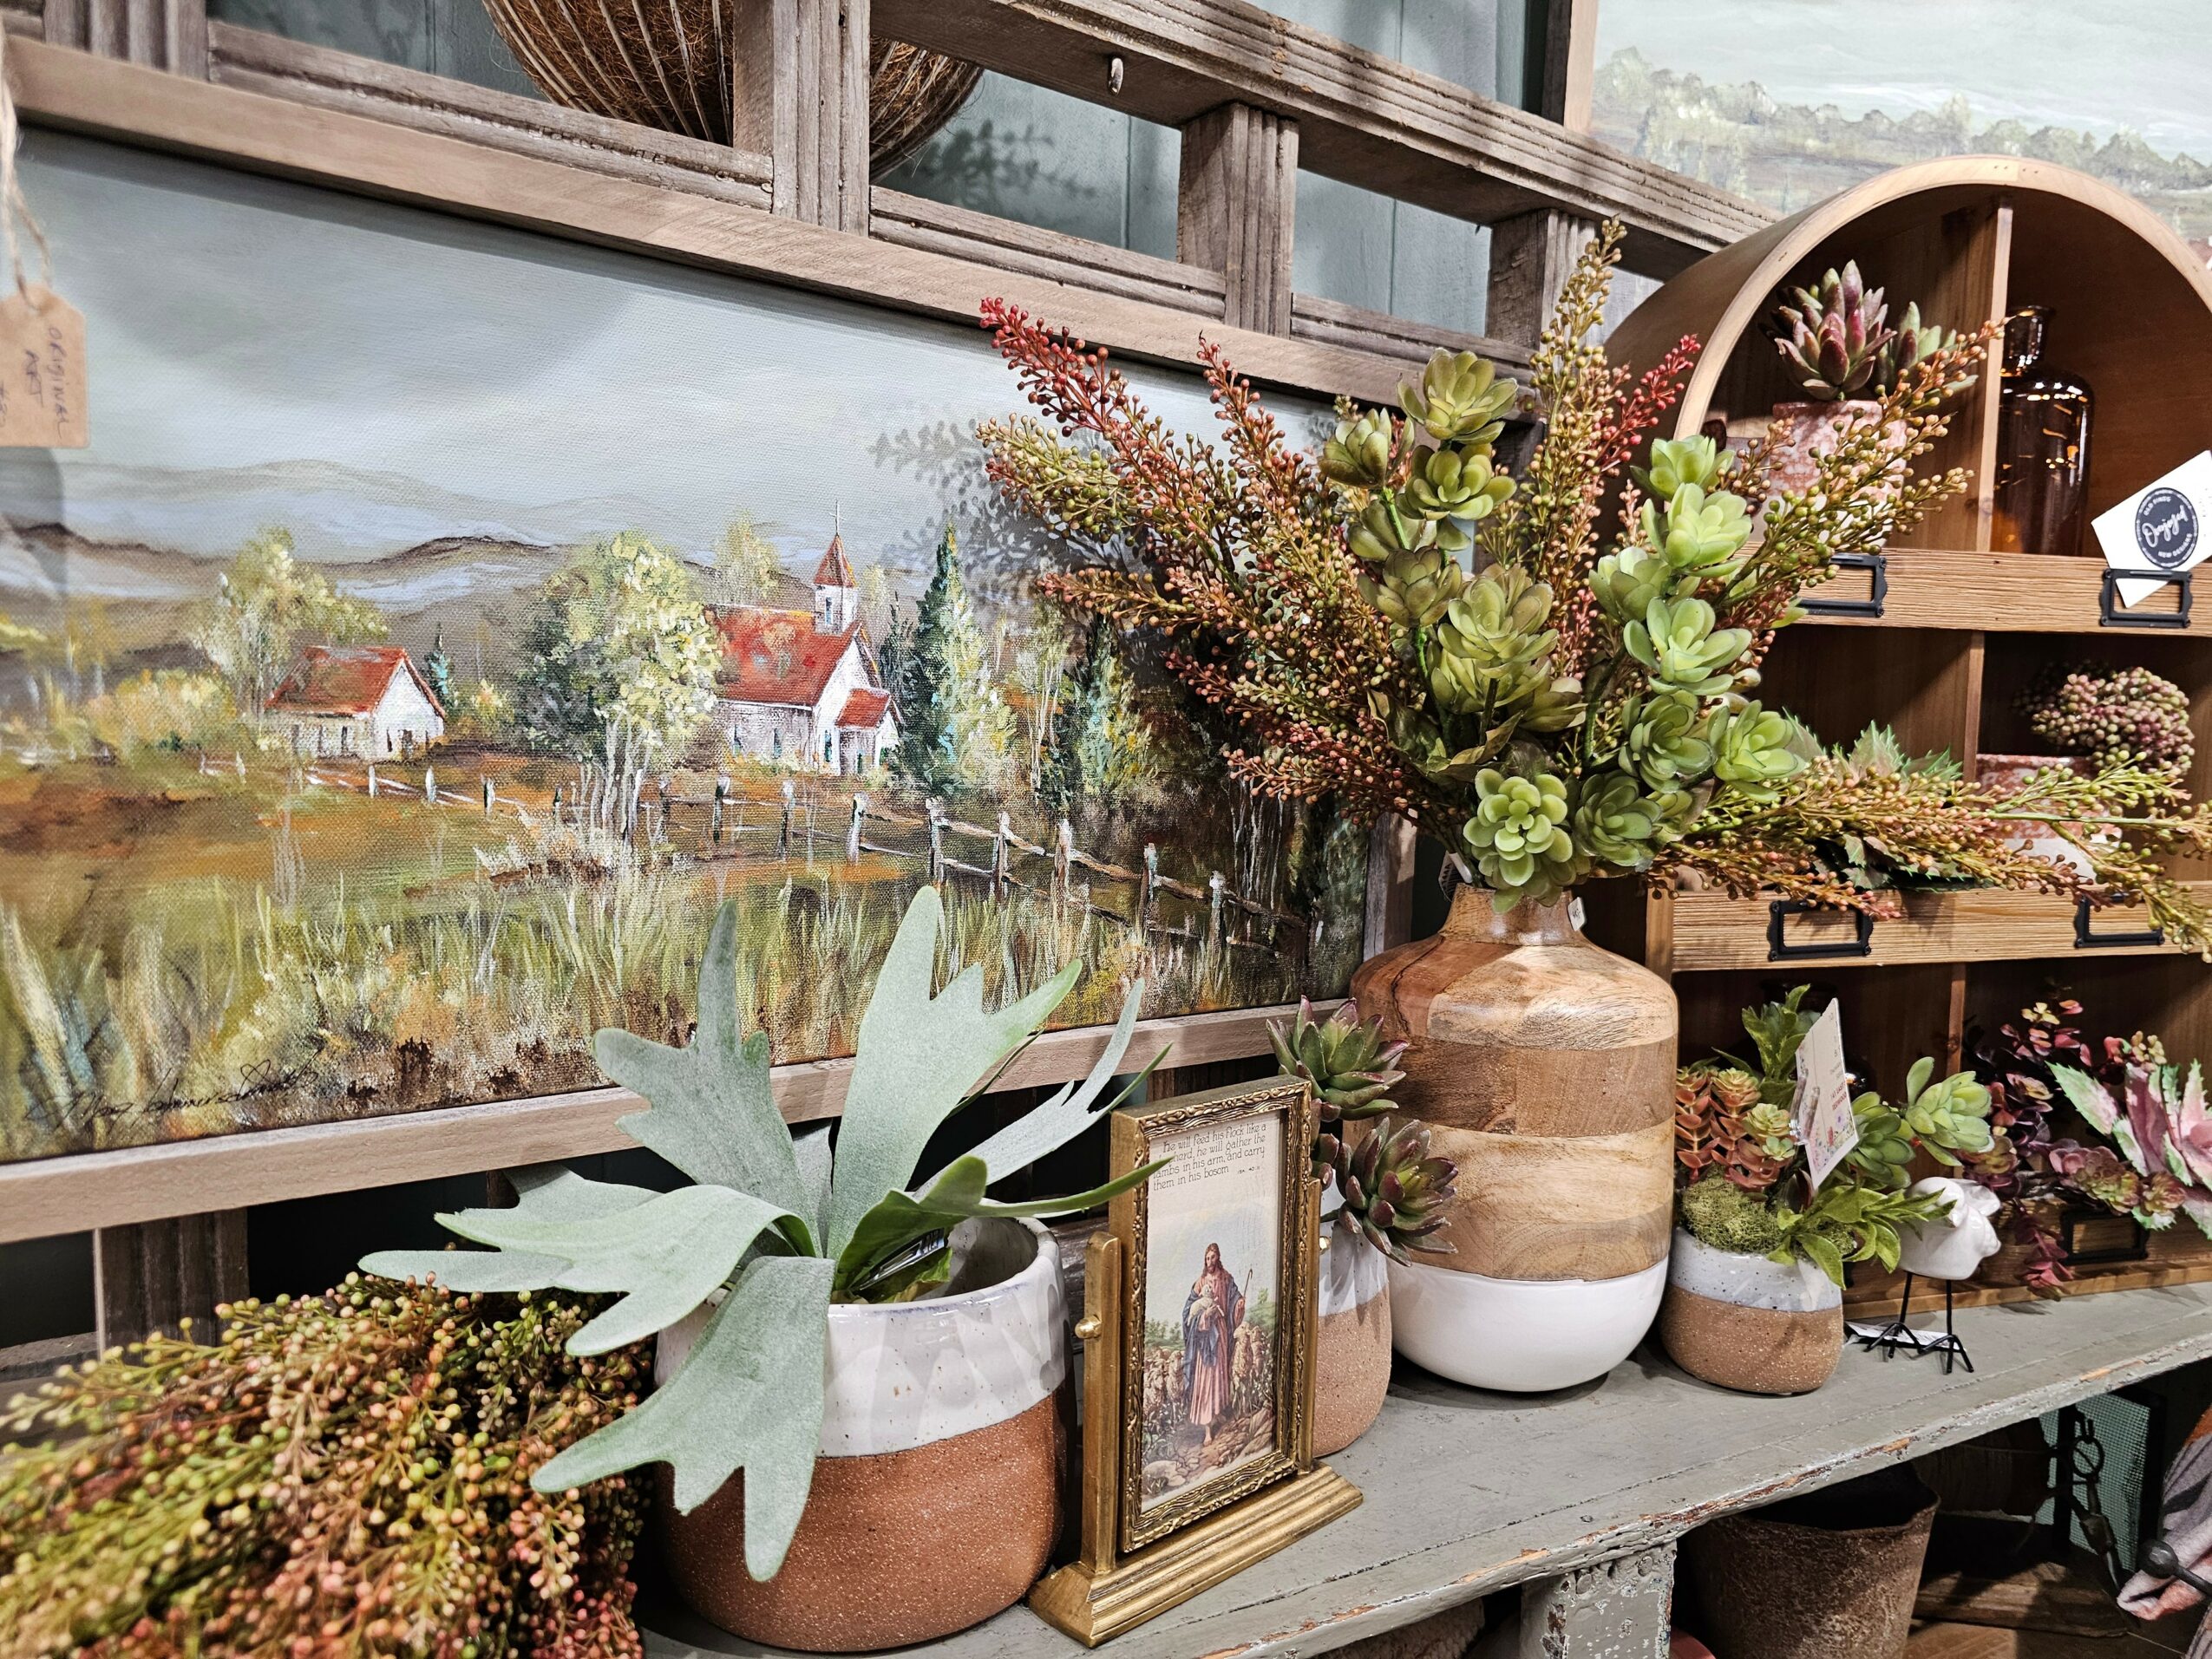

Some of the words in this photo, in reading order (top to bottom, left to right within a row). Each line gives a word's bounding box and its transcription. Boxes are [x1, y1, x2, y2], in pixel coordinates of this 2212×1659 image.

[1178, 1137, 1191, 1149] will
[1194, 1133, 1209, 1146] feed
[1213, 1130, 1224, 1142] his
[1226, 1126, 1244, 1139] flock
[1247, 1123, 1260, 1133] like
[1197, 1146, 1207, 1157] he
[1209, 1141, 1223, 1154] will
[1226, 1137, 1252, 1156] gather
[1254, 1133, 1265, 1144] the
[1183, 1161, 1191, 1172] in
[1193, 1158, 1205, 1170] his
[1207, 1155, 1226, 1166] arm,
[1227, 1149, 1242, 1161] and
[1244, 1146, 1264, 1158] carry
[1153, 1177, 1175, 1192] them
[1178, 1174, 1186, 1185] in
[1189, 1171, 1201, 1183] his
[1204, 1165, 1229, 1179] bosom
